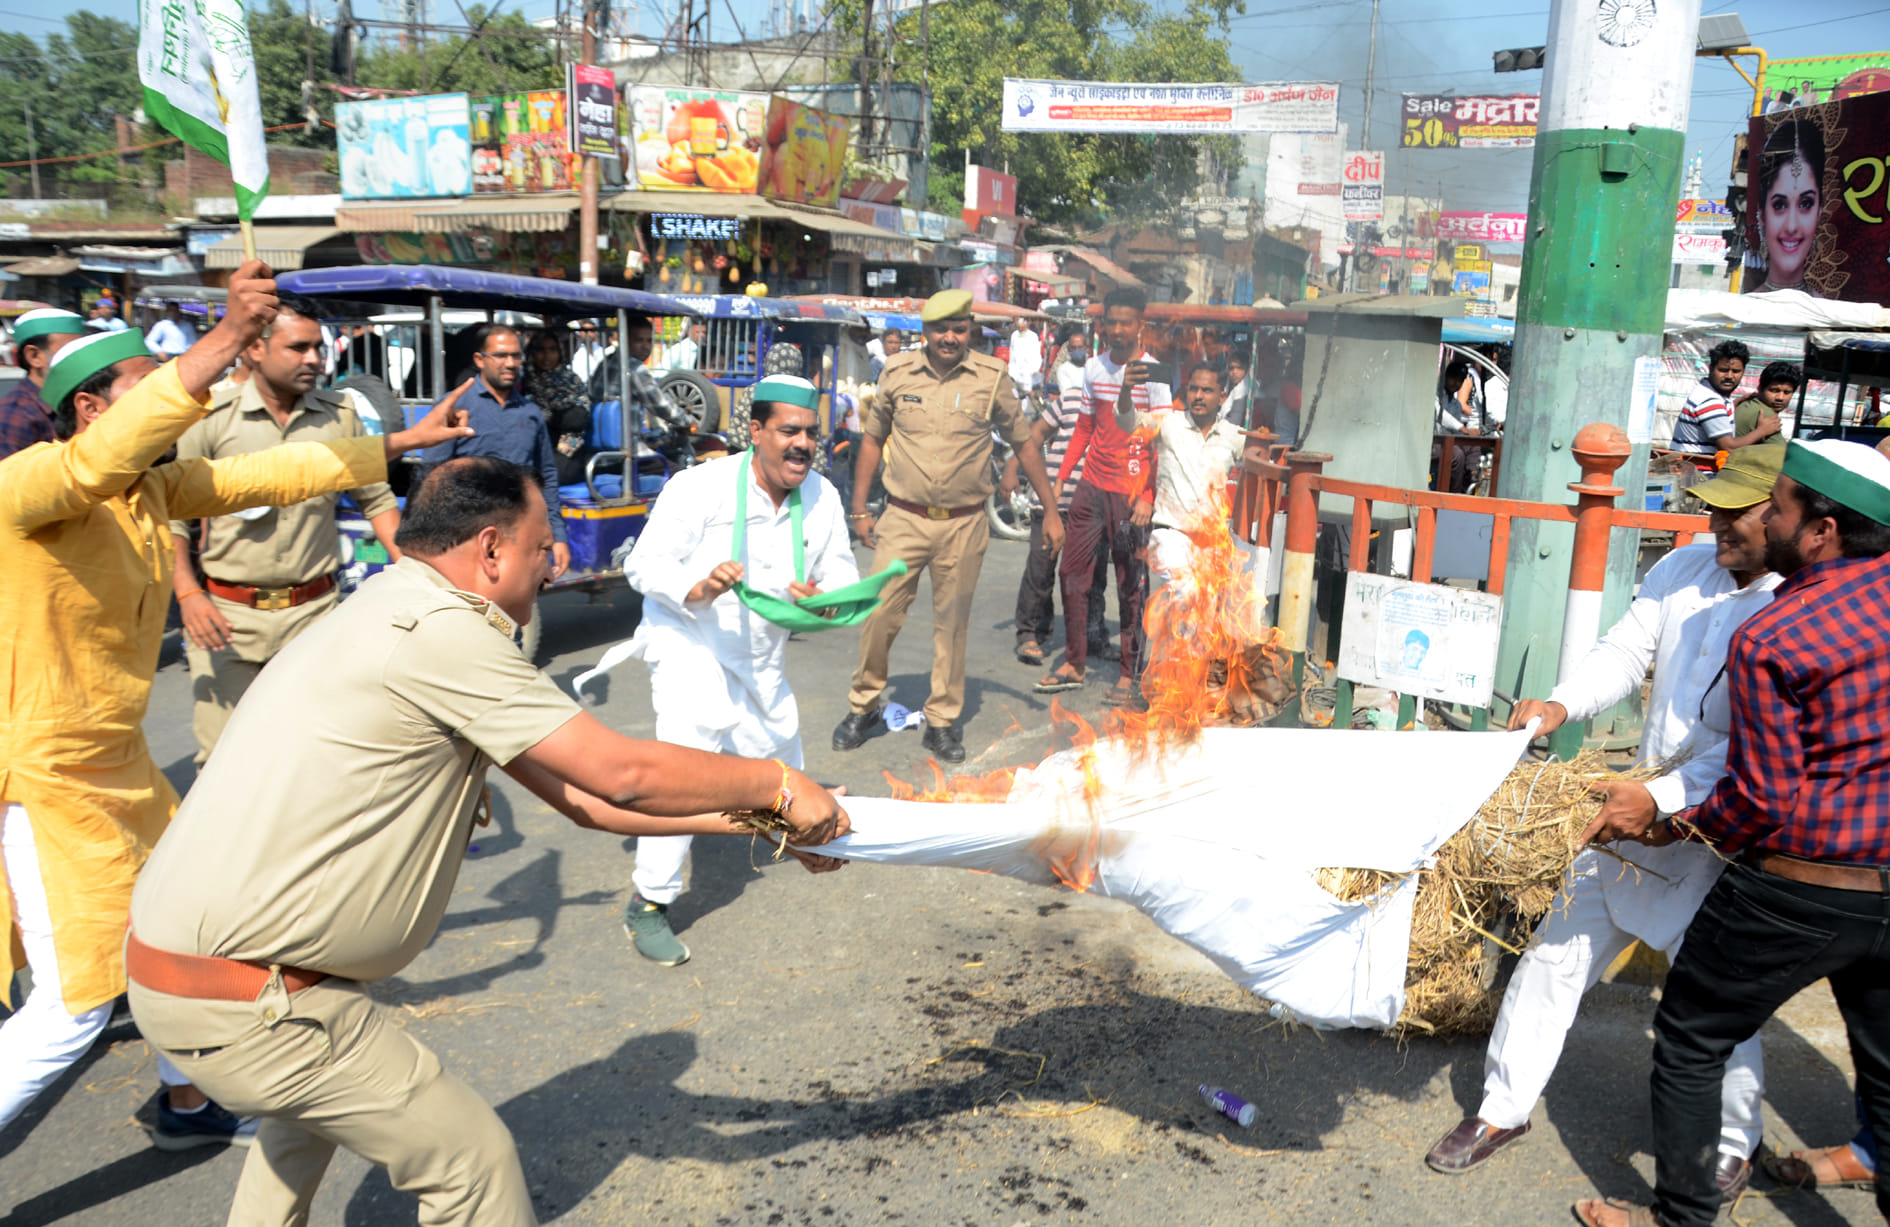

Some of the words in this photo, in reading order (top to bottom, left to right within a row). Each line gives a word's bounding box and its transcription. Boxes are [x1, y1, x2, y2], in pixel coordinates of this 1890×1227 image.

[1406, 98, 1452, 112] Sale
[1404, 118, 1457, 147] 50%
[1345, 156, 1381, 182] दीप
